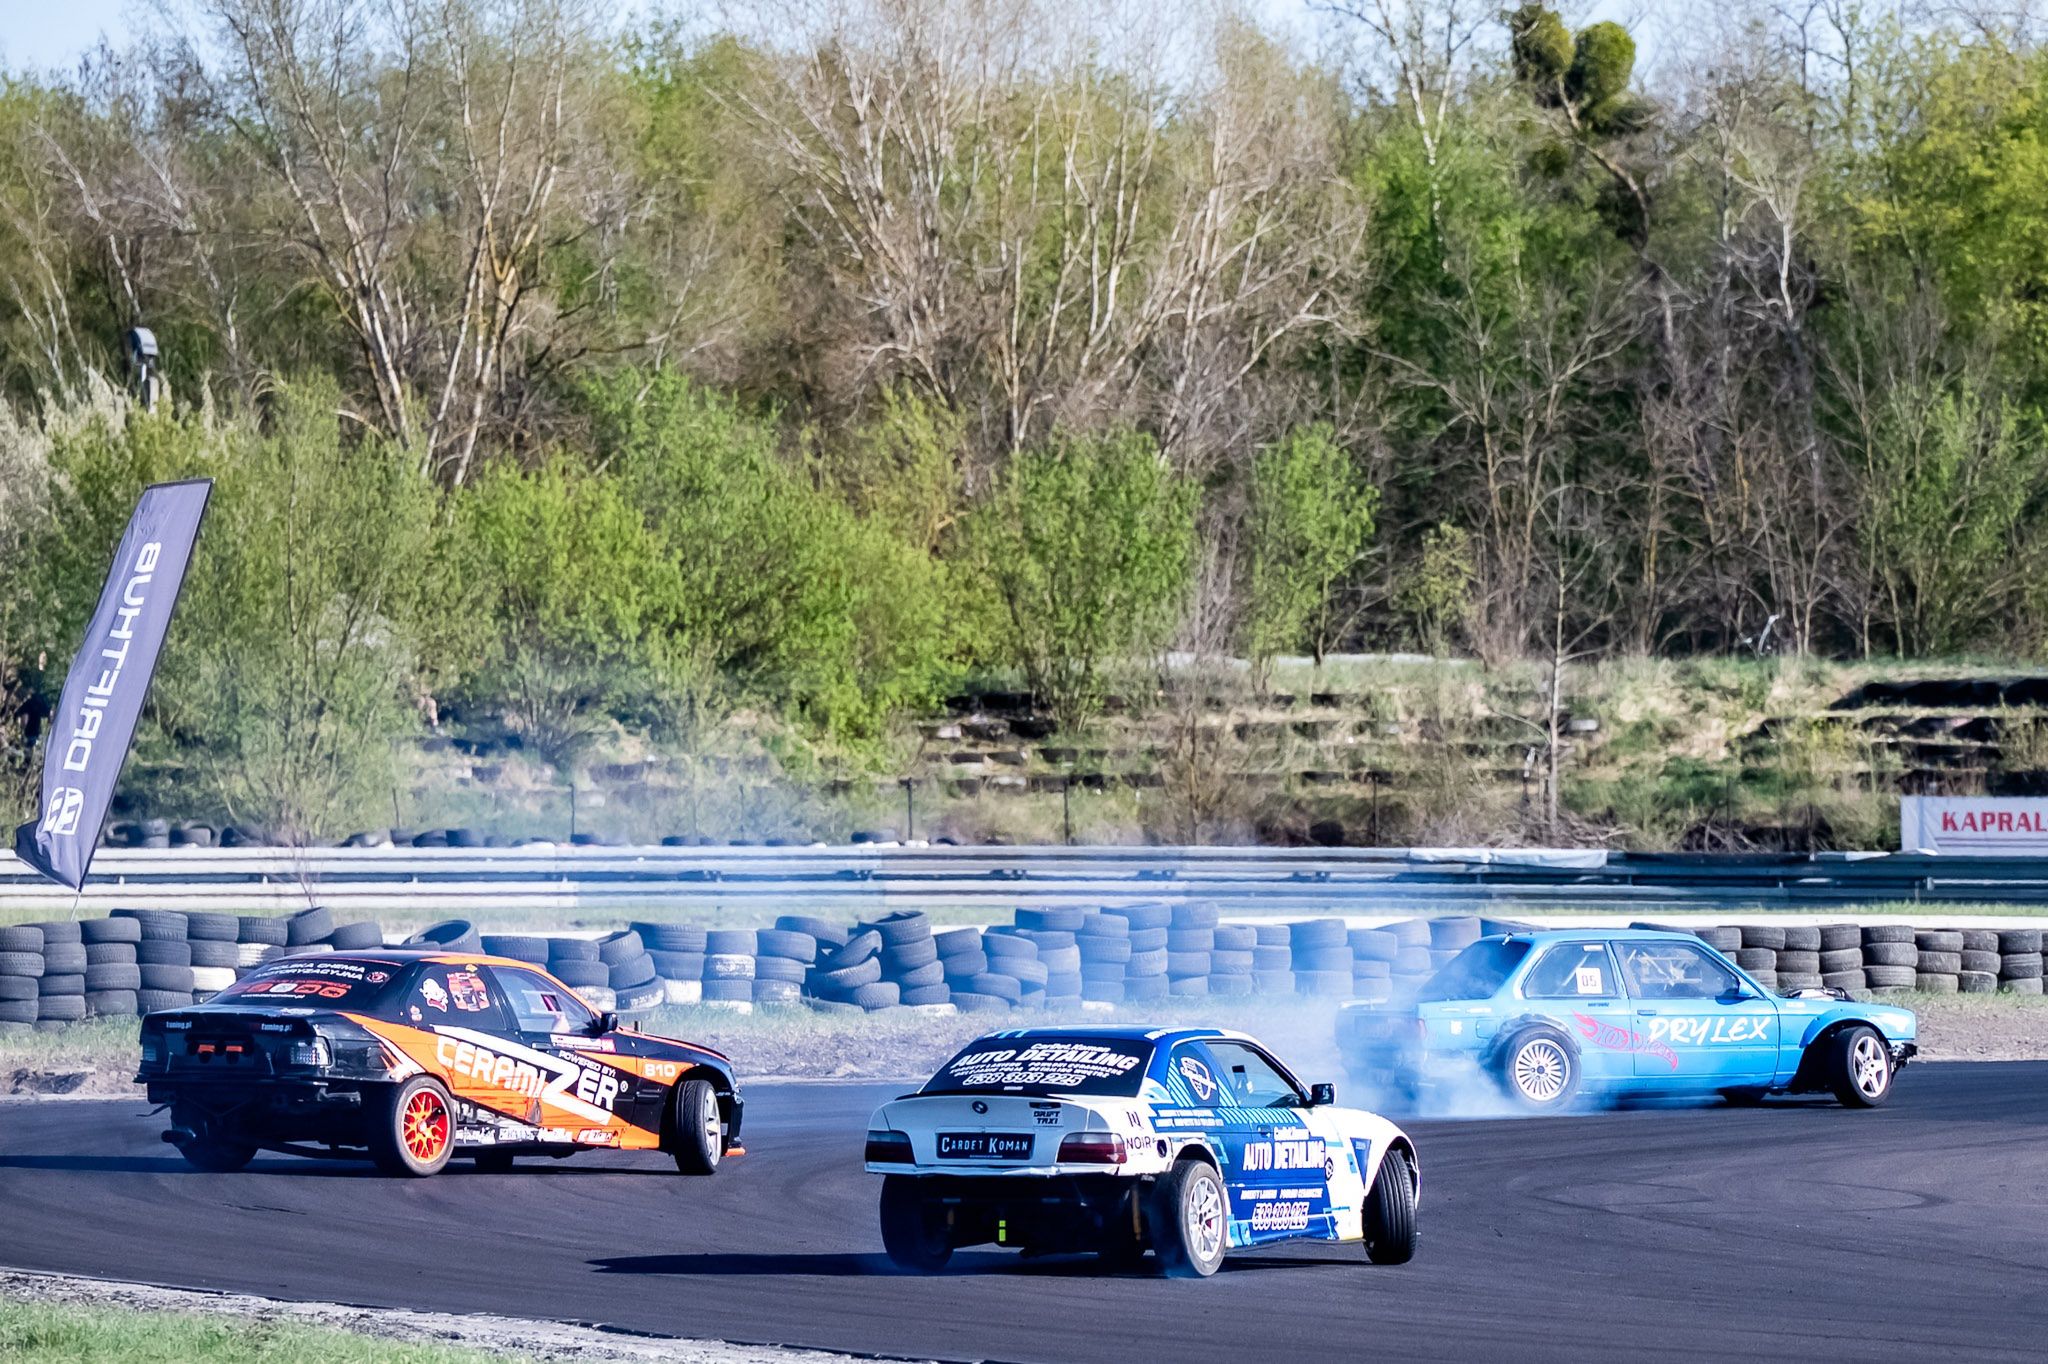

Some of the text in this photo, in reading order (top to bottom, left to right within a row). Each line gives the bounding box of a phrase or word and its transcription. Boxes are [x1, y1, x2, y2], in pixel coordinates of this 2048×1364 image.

[1942, 811, 2048, 832] KAPRAL
[254, 969, 364, 981] MOTORYZACYJNA
[316, 962, 365, 974] CHEMIA
[1581, 974, 1598, 987] 05
[1648, 1016, 1772, 1045] DRYLEX
[558, 1050, 602, 1072] POWERED
[949, 1049, 1140, 1071] AUTO DETAILING
[437, 1034, 620, 1114] CERAMIZER
[1038, 1072, 1087, 1087] 225
[1033, 1110, 1061, 1118] DRIFT
[1036, 1117, 1059, 1125] TAXI
[941, 1137, 1029, 1153] CARDET KOMAN
[1126, 1136, 1151, 1150] NOIR
[1242, 1142, 1273, 1171] AUTO
[1273, 1140, 1326, 1170] DETAILING
[1289, 1202, 1310, 1230] 225
